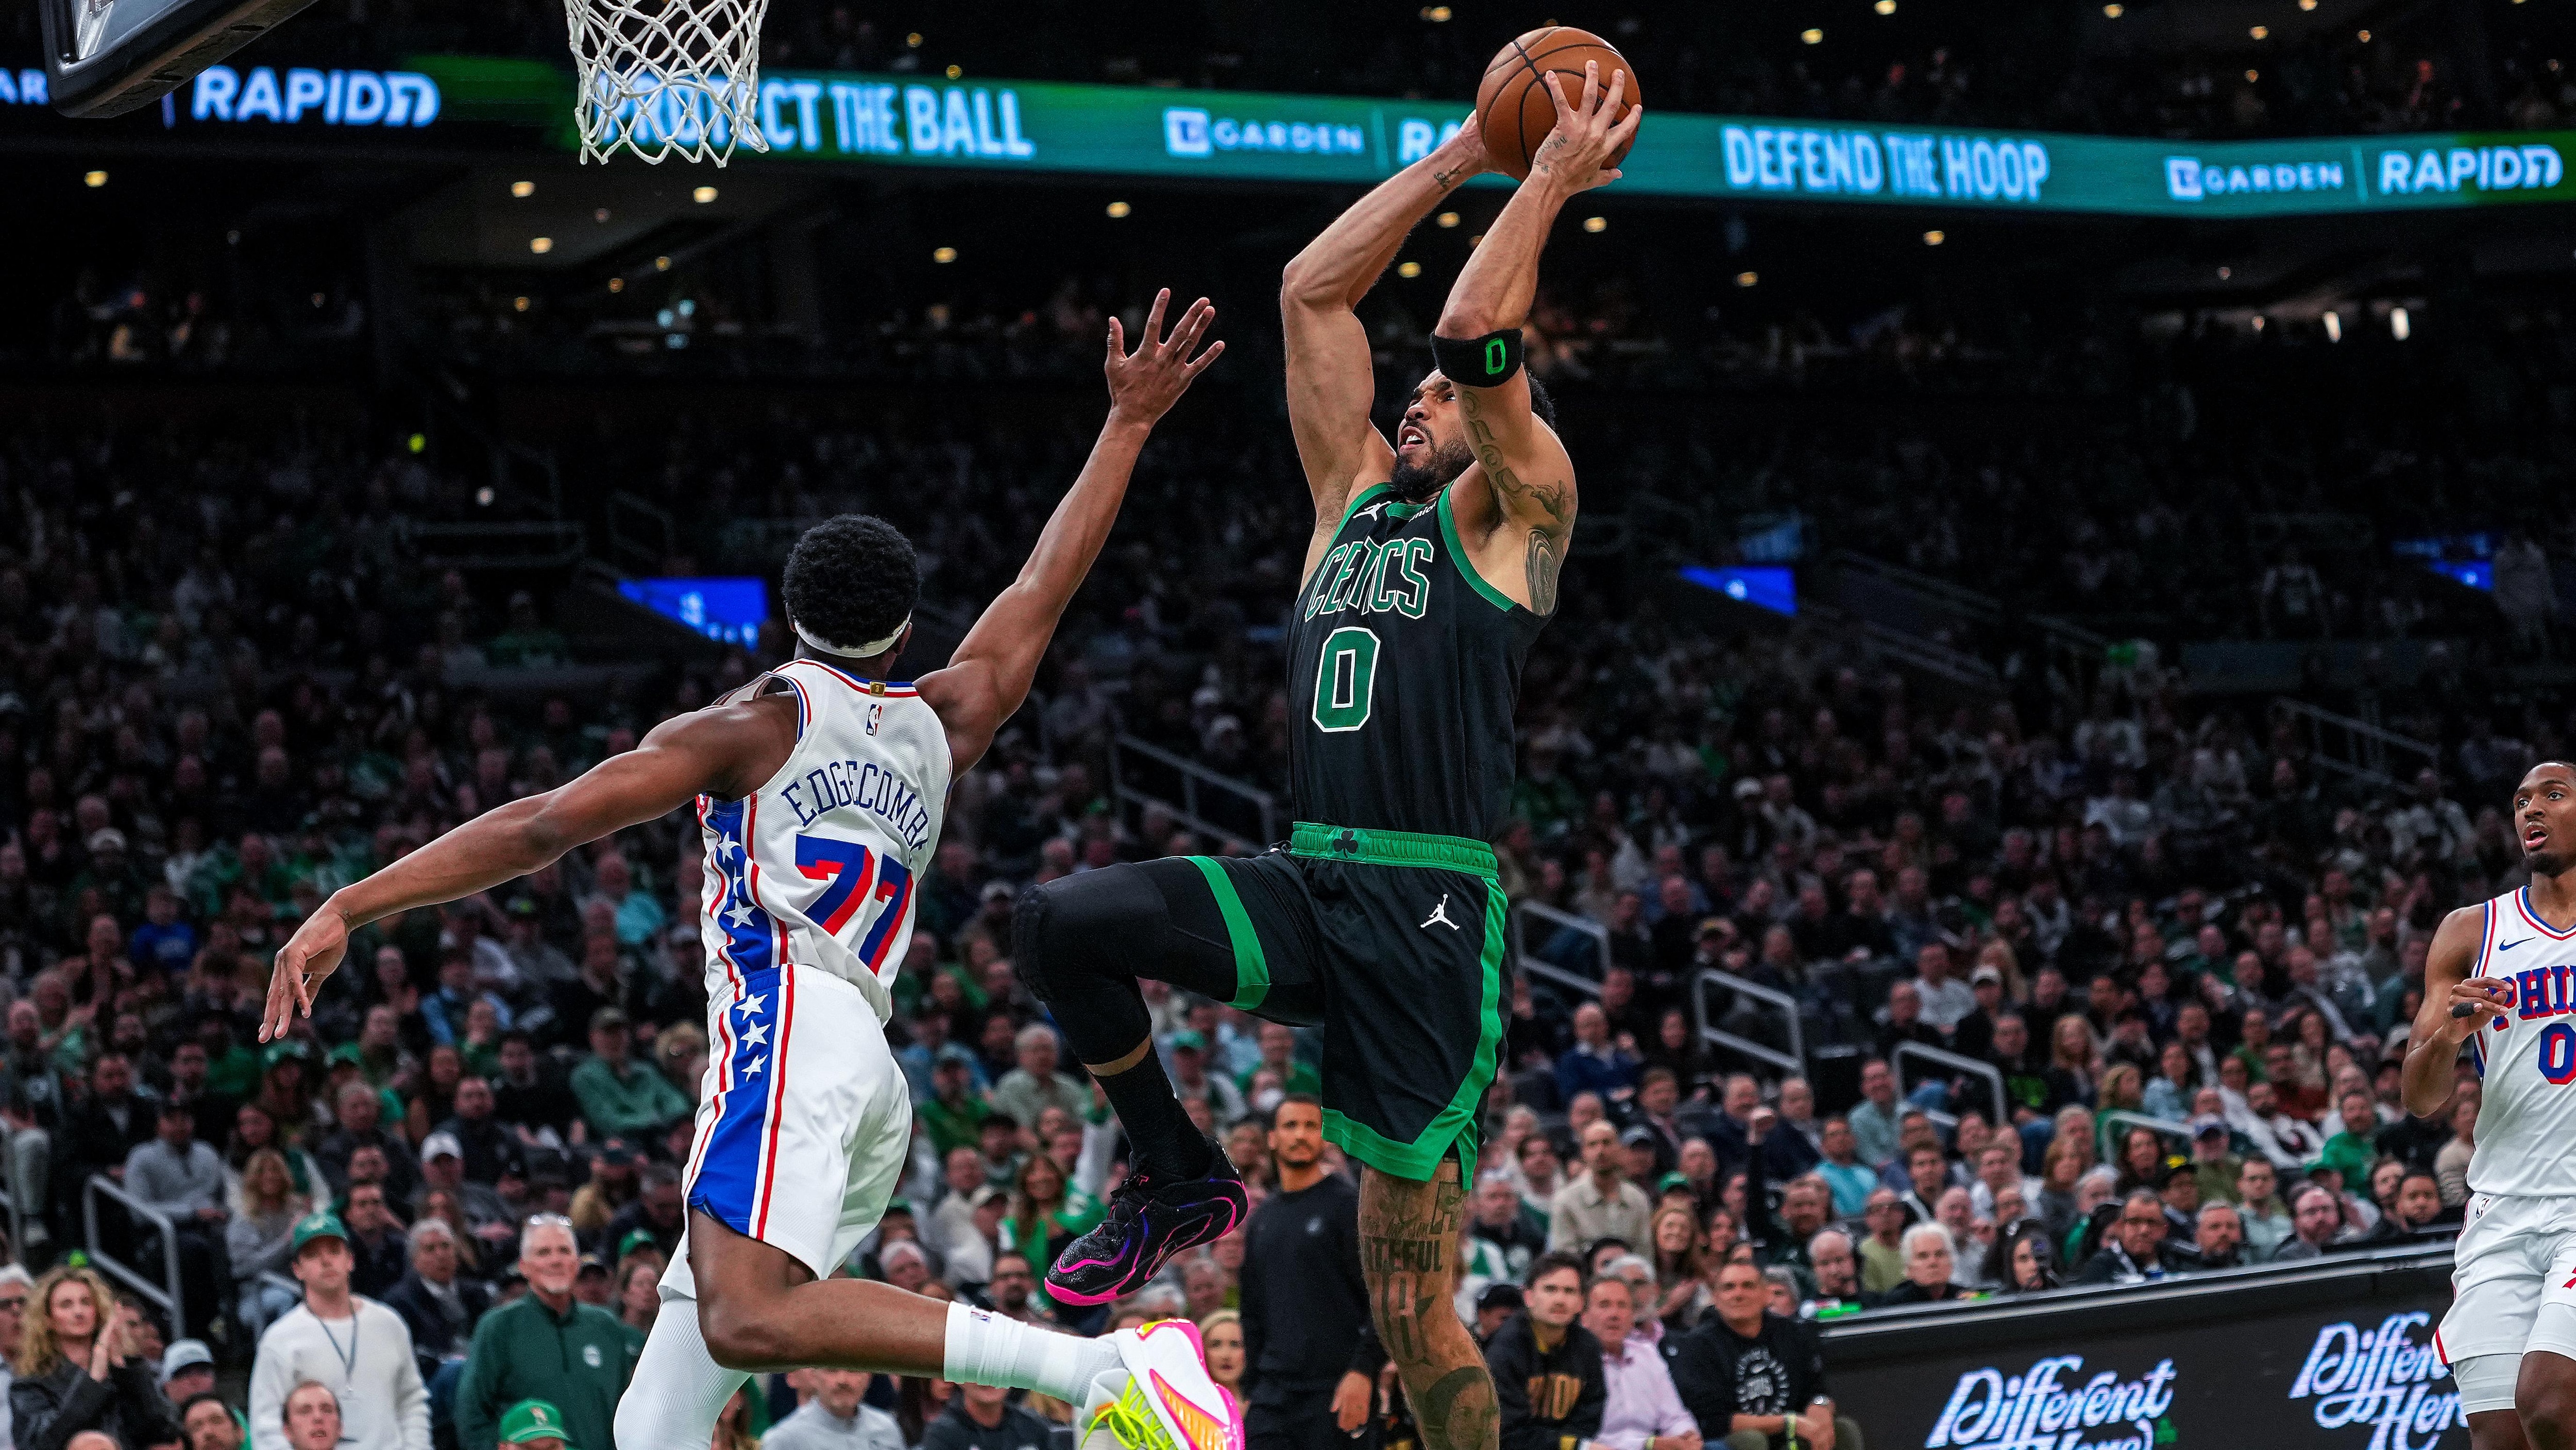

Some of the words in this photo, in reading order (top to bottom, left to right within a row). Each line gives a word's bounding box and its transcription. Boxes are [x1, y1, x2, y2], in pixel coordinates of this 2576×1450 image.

[828, 81, 904, 153] THE
[904, 84, 1036, 160] BALL
[1213, 118, 1364, 155] GARDEN
[1721, 124, 1885, 195] DEFEND
[1883, 131, 1942, 197] THE
[1941, 134, 2050, 202] HOOP
[2203, 161, 2344, 195] GARDEN
[1305, 536, 1434, 623] CETCS
[1312, 626, 1381, 732] 0
[795, 834, 913, 977] 77
[2488, 965, 2576, 1032] PHI
[2538, 1023, 2576, 1085] 0
[1924, 1355, 2177, 1448] Different
[2288, 1311, 2450, 1428] Differ
[2367, 1383, 2469, 1450] Her
